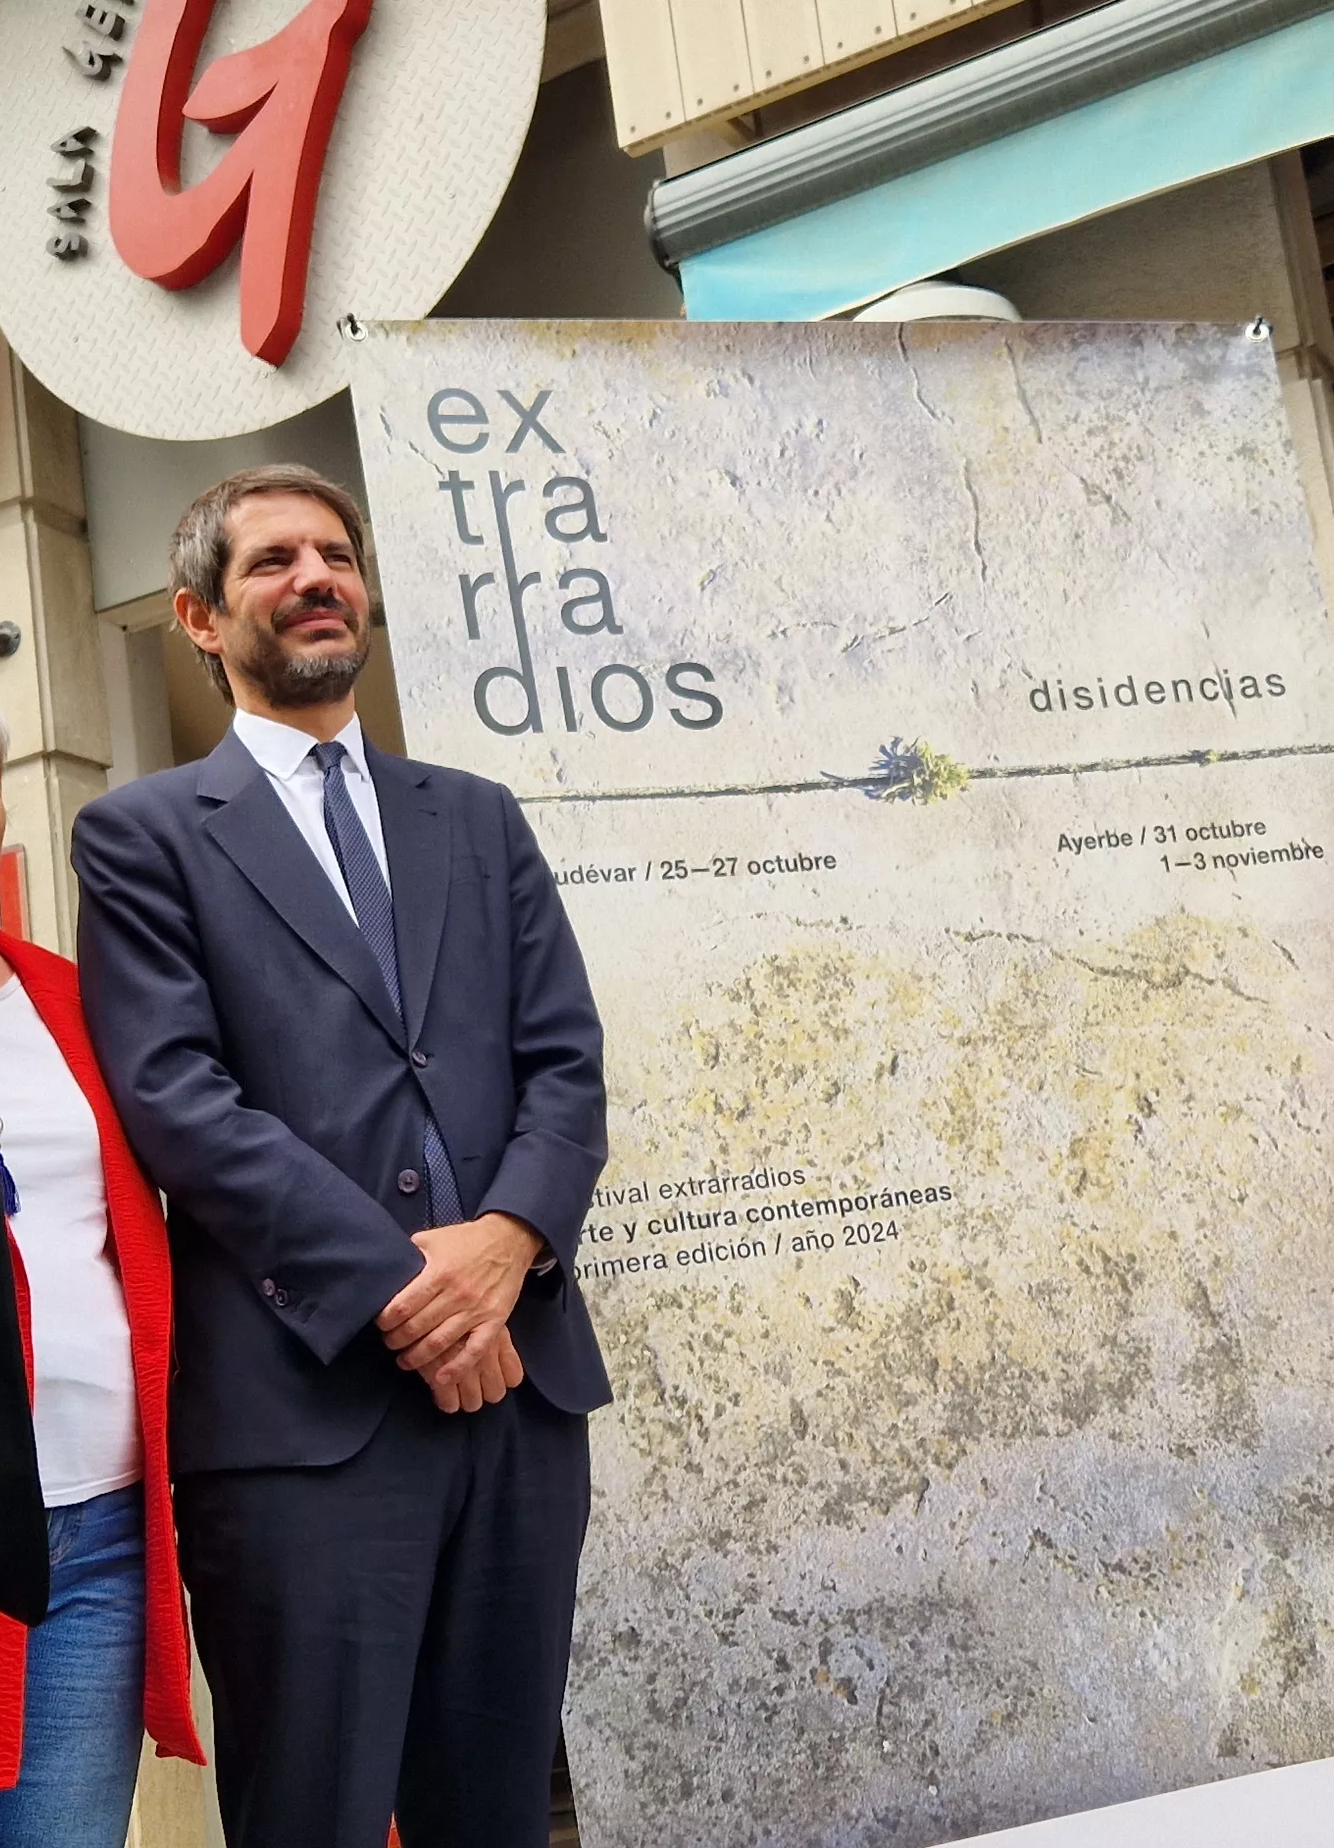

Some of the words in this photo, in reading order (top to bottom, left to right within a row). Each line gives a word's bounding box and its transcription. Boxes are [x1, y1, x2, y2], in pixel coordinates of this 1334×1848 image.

[427, 387, 567, 454] ex
[1029, 668, 1287, 712] disidencias
[1057, 828, 1133, 855] Ayerbe
[1153, 825, 1178, 844] 31
[1186, 819, 1267, 842] octubre
[1213, 841, 1325, 869] noviembre
[554, 863, 636, 885] udévar
[747, 852, 837, 875] octubre
[589, 1181, 649, 1208] tival
[659, 1166, 806, 1200] extrarradios
[579, 1223, 614, 1246] rte
[623, 1221, 637, 1244] y
[648, 1210, 737, 1235] cultura
[746, 1184, 953, 1224] contemporáneas
[676, 1237, 766, 1267] edición
[791, 1231, 834, 1252] año
[843, 1220, 900, 1247] 2024
